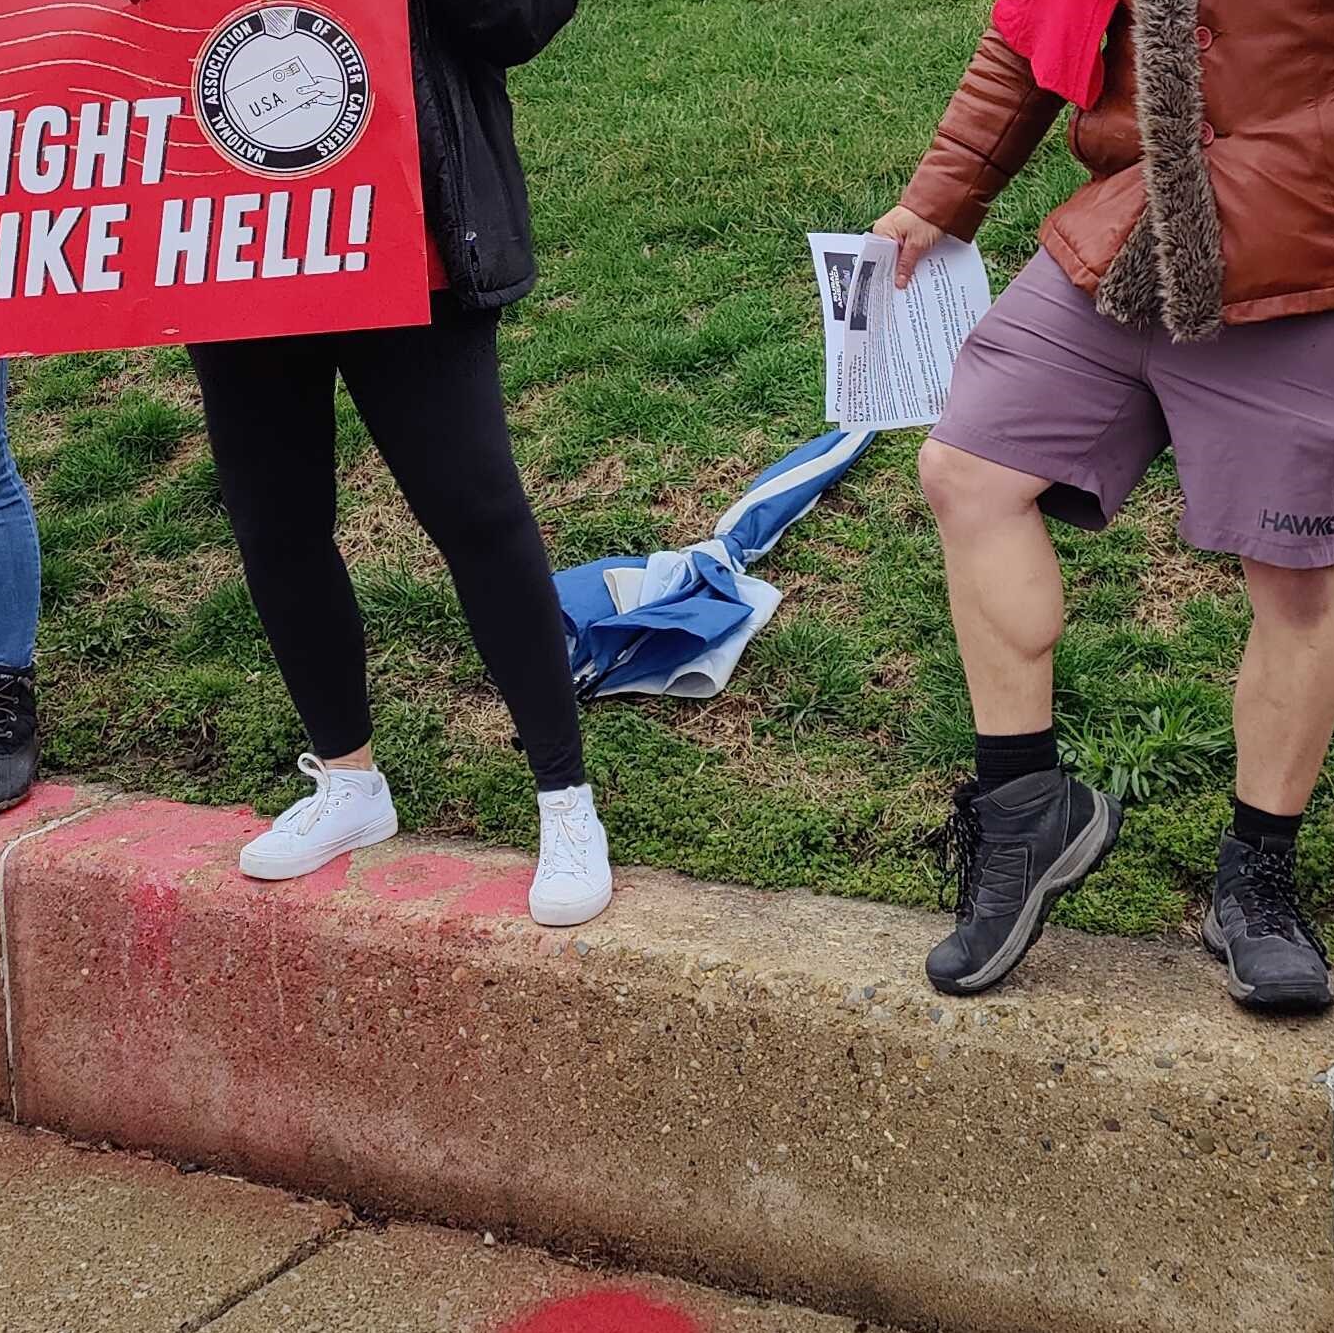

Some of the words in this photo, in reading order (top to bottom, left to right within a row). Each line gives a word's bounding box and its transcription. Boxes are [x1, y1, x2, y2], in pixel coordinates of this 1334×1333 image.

[311, 19, 331, 36] OF
[204, 21, 253, 105] ASSOCIATION
[331, 35, 363, 84] LETTER
[248, 92, 287, 117] U.S.A.
[317, 93, 363, 156] CARRIERS
[210, 112, 266, 164] NATIONAL
[154, 185, 373, 288] HELL!
